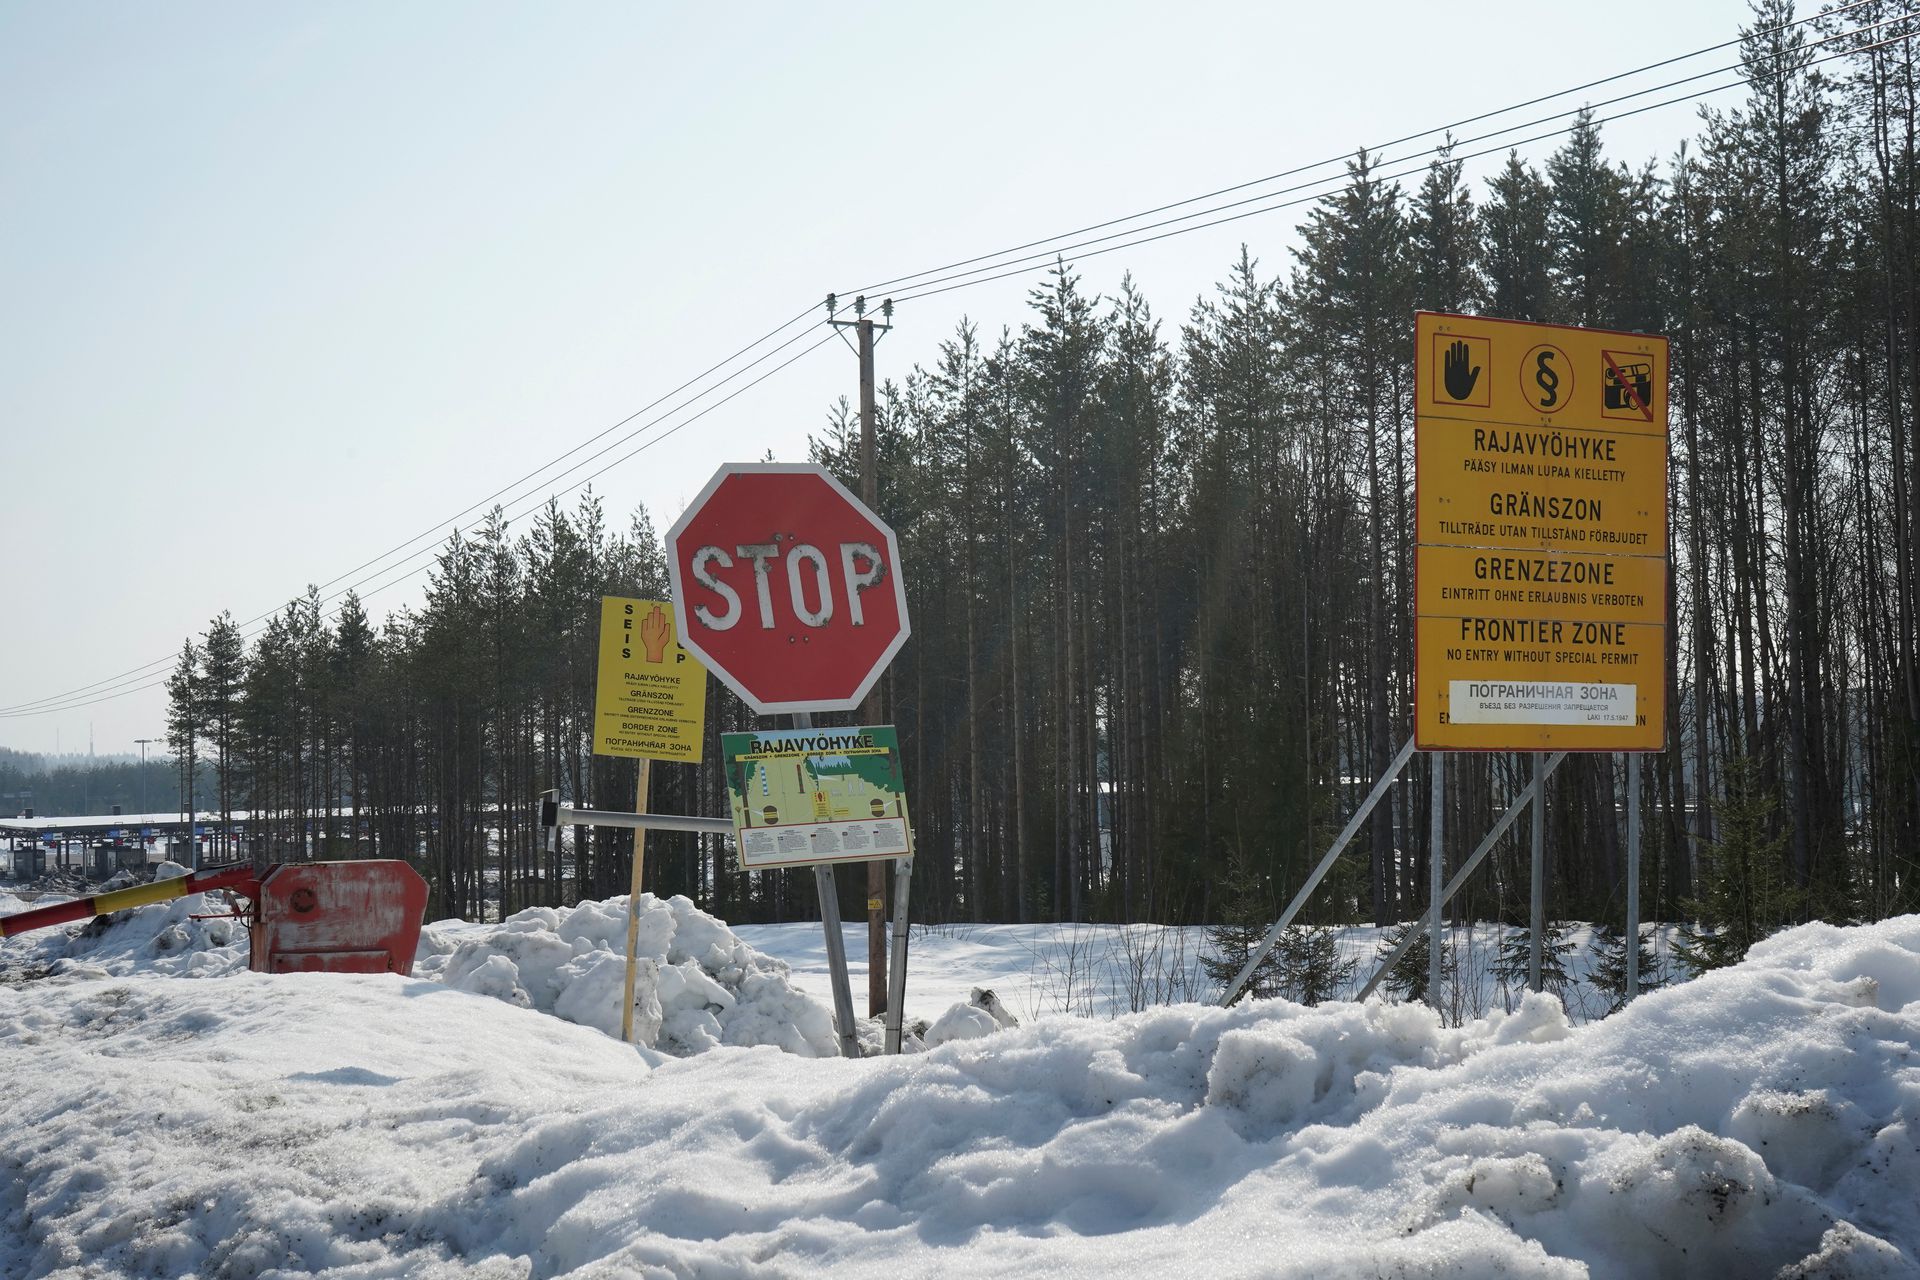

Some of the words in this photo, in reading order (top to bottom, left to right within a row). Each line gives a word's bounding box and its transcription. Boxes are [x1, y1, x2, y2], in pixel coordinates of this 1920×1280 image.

[1475, 429, 1616, 462] RAJAVYÖHYKE
[1464, 459, 1497, 473] PÄÄSY
[1501, 464, 1534, 476] ILMAN
[1538, 466, 1570, 478] LUPAA
[1574, 469, 1625, 482] KIELLETTY
[1491, 492, 1601, 521] GRÄNSZON
[1440, 522, 1495, 536] TILLTRÄDE
[1500, 526, 1527, 538] UTAN
[1532, 527, 1586, 541] TILLSTÅND
[1590, 529, 1647, 545] FÖRBJUDET
[1475, 557, 1614, 585] GRENZEZONE
[692, 543, 887, 631] STOP
[1442, 588, 1490, 600] EINTRITT
[1495, 591, 1524, 602] OHNE
[1528, 592, 1587, 605] ERLAUBNIS
[1592, 594, 1644, 606] VERBOTEN
[1462, 618, 1563, 644] FRONTIER
[1572, 623, 1626, 645] ZONE
[1447, 649, 1462, 661] NO
[1466, 650, 1499, 662] ENTRY
[1504, 651, 1551, 663] WITHOUT
[1555, 652, 1597, 664] SPECIAL
[1601, 653, 1639, 665] PERMIT
[625, 673, 681, 685] RAJAVYÖHYKE
[631, 690, 674, 700] GRÄNSZON
[1470, 684, 1573, 699] ПОГРАНИЧНАЯ
[1581, 687, 1618, 700] ЗОНА
[628, 706, 674, 717] GRENZZONE
[1480, 703, 1501, 711] ВЪЕЗД
[622, 723, 654, 732] BORDER
[658, 726, 678, 734] ZONE
[670, 743, 692, 752] ЗОНА
[751, 733, 874, 754] RAJAVYÖHYKE
